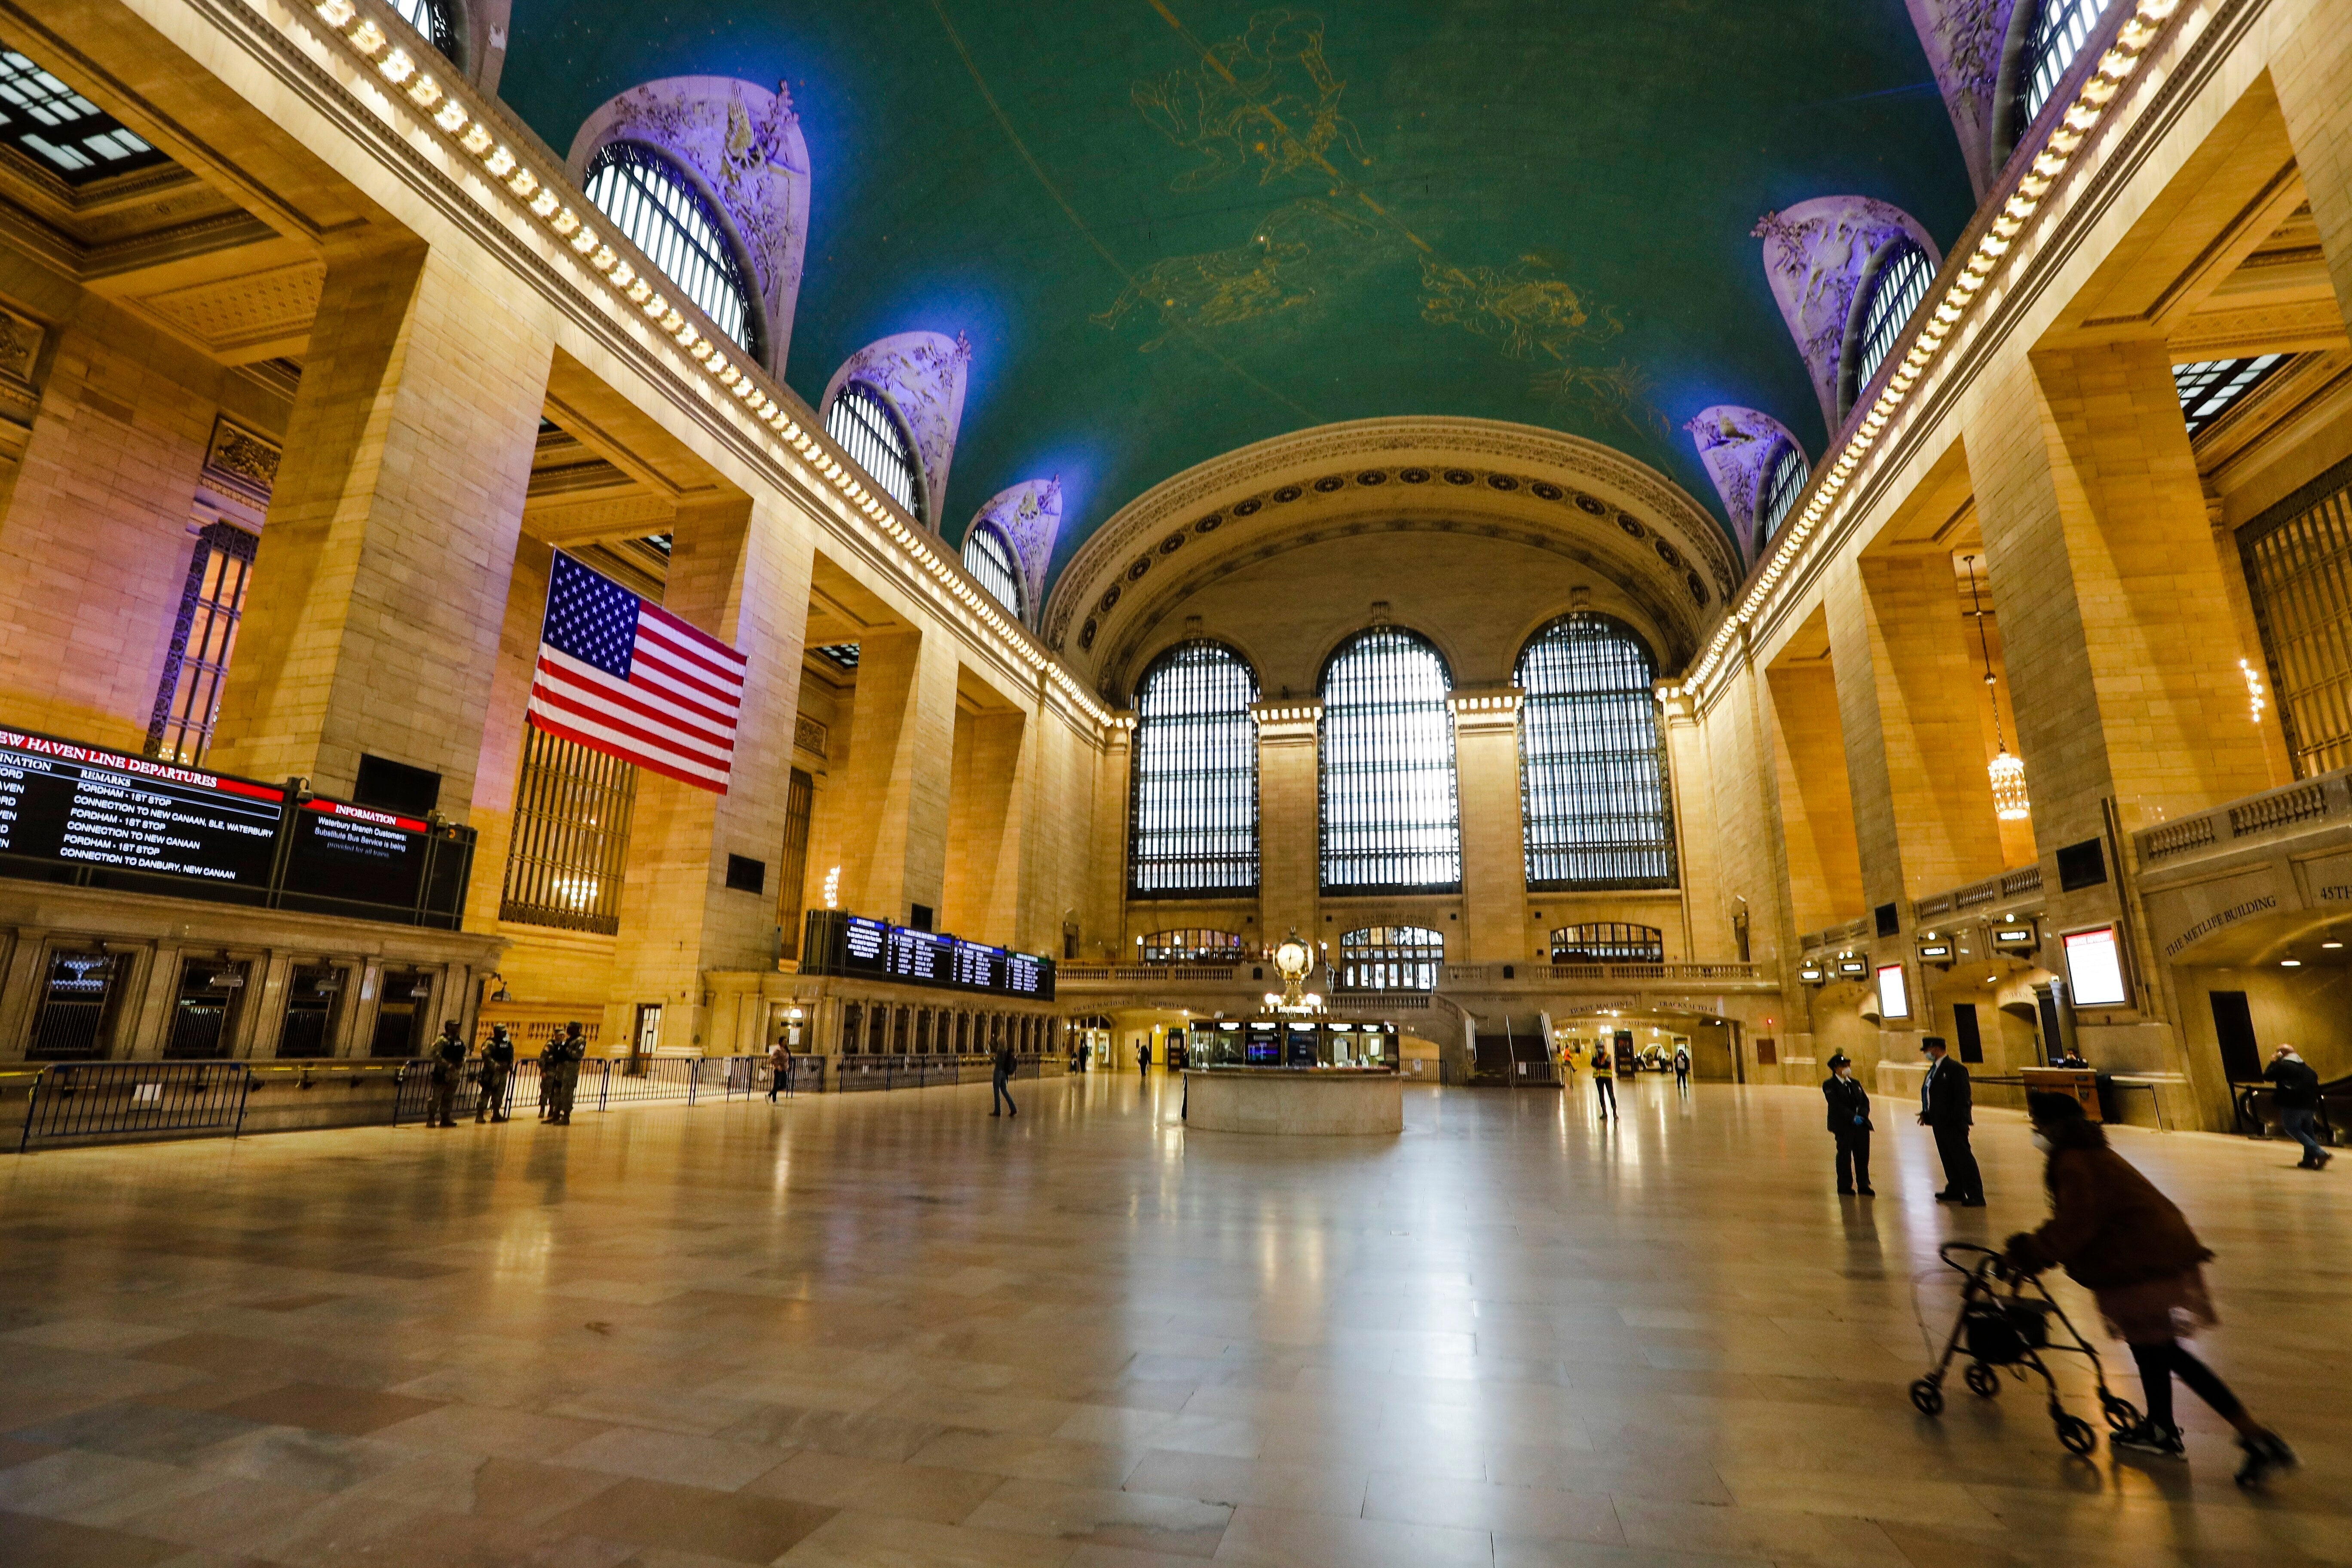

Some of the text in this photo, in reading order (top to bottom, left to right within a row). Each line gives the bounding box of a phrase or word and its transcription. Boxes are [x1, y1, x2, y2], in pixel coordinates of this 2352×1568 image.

[26, 737, 86, 761] HAVEN
[88, 753, 126, 769] LINE
[128, 759, 217, 788] DEPARTURES
[80, 769, 132, 787] REMARKS
[0, 767, 24, 779] ORD
[77, 782, 124, 798] FORDHAM
[131, 793, 147, 802] 1ST
[148, 795, 172, 807] STOP
[0, 795, 16, 806] RD
[70, 807, 118, 824] FORDHAM
[125, 817, 141, 827] 1ST
[142, 820, 166, 831] STOP
[74, 795, 135, 813] CONNECTION
[136, 805, 149, 816] TO
[150, 808, 171, 820] NEW
[172, 812, 206, 827] CANAAN,
[208, 819, 225, 830] SLE,
[227, 822, 274, 838] WATERBURY
[317, 816, 351, 831] Waterbury
[351, 823, 373, 835] Branch
[335, 804, 397, 825] INFORMATION
[0, 824, 9, 833] D
[64, 833, 112, 849] FORDHAM
[119, 842, 135, 852] 1ST
[136, 845, 160, 855] STOP
[67, 821, 129, 838] CONNECTION
[131, 830, 143, 841] TO
[144, 833, 165, 844] NEW
[166, 836, 200, 850] CANAAN
[315, 827, 346, 840] Substitute
[347, 833, 359, 843] Bus
[361, 836, 383, 848] Service
[390, 841, 406, 853] being
[327, 841, 354, 852] provided
[60, 847, 123, 864] CONNECTION
[125, 856, 137, 866] TO
[138, 858, 181, 873] DANBURY,
[183, 864, 202, 875] NEW
[203, 867, 236, 879] CANAAN
[2165, 894, 2277, 957] THE METLIFE BUILDING
